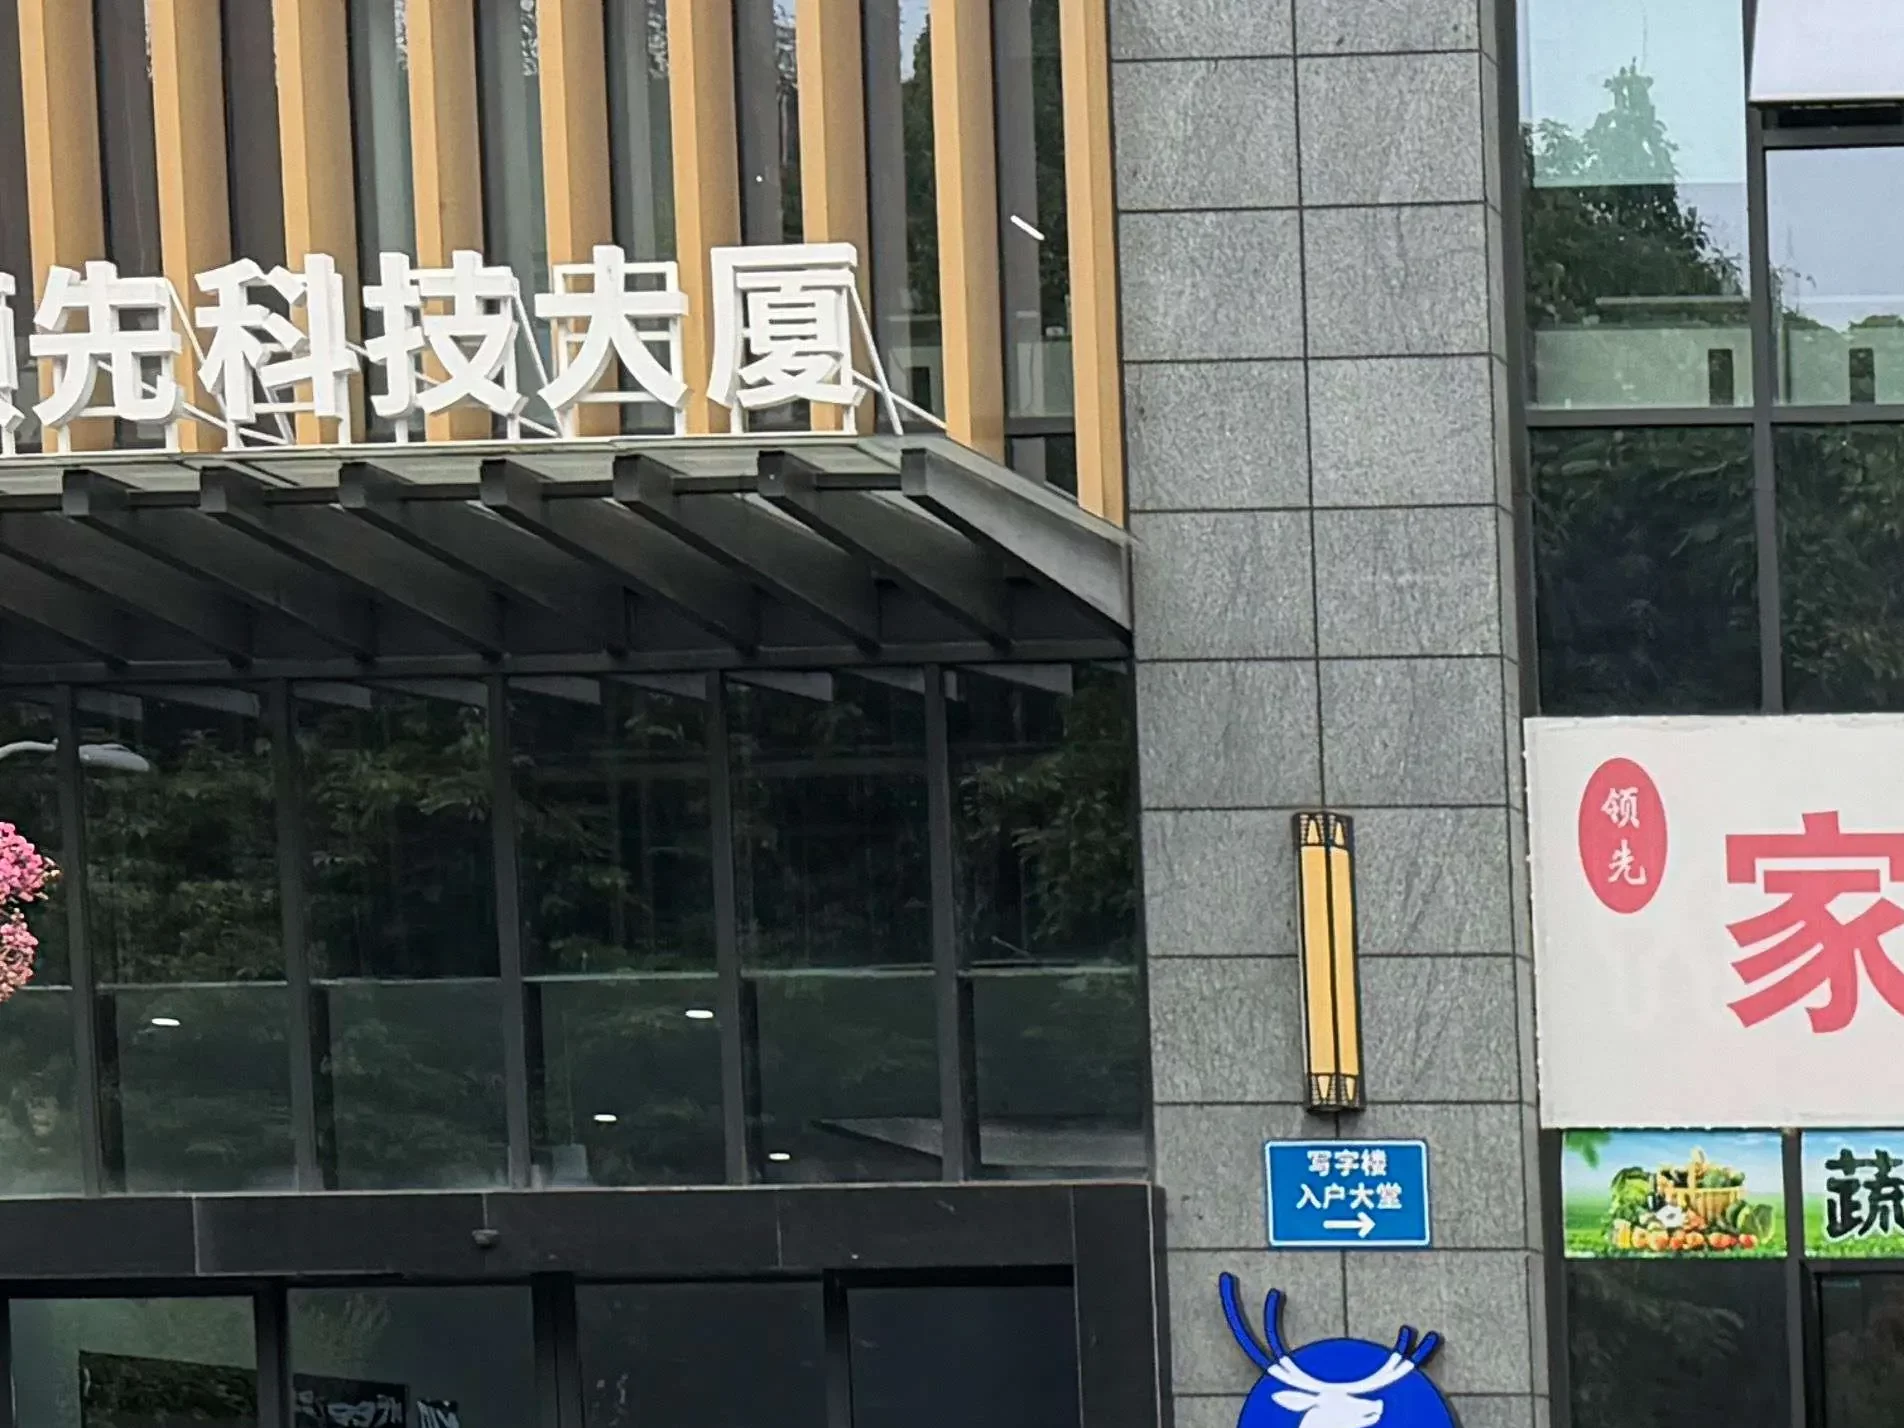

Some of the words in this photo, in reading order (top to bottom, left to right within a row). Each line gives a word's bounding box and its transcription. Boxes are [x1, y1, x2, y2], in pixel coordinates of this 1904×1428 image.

[1306, 1148, 1388, 1177] 写字楼
[1295, 1181, 1403, 1210] 入户大堂
